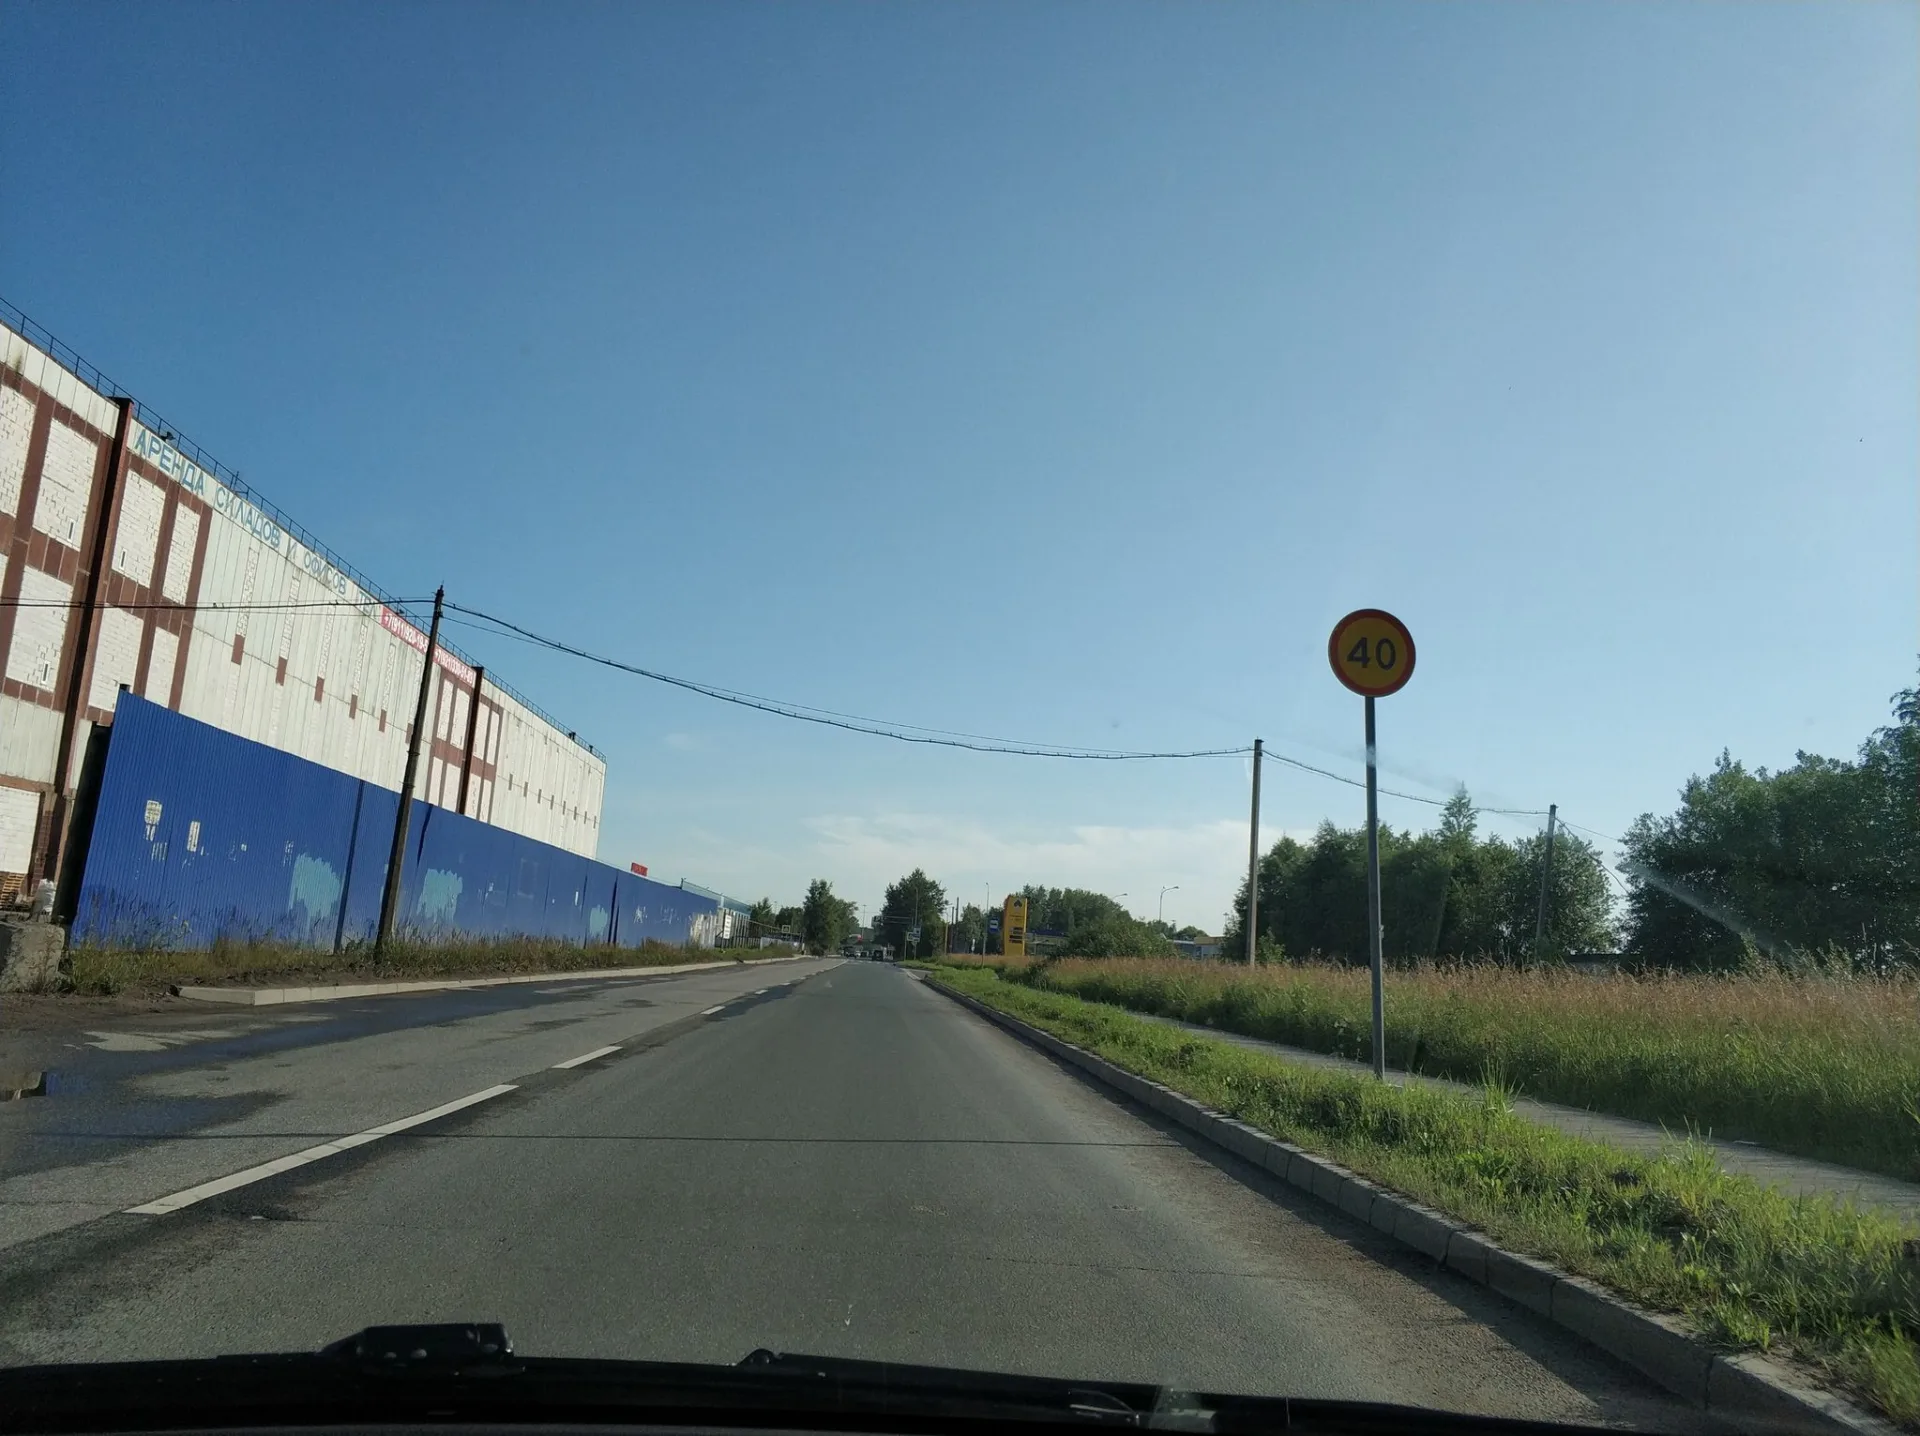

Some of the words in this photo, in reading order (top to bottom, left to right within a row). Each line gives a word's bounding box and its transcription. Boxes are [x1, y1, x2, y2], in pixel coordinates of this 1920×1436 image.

[134, 428, 204, 496] АРЕНДА
[215, 486, 281, 548] СКЛАДОВ
[287, 541, 297, 559] И
[304, 550, 346, 595] ОФИСОВ
[1346, 636, 1397, 671] 40
